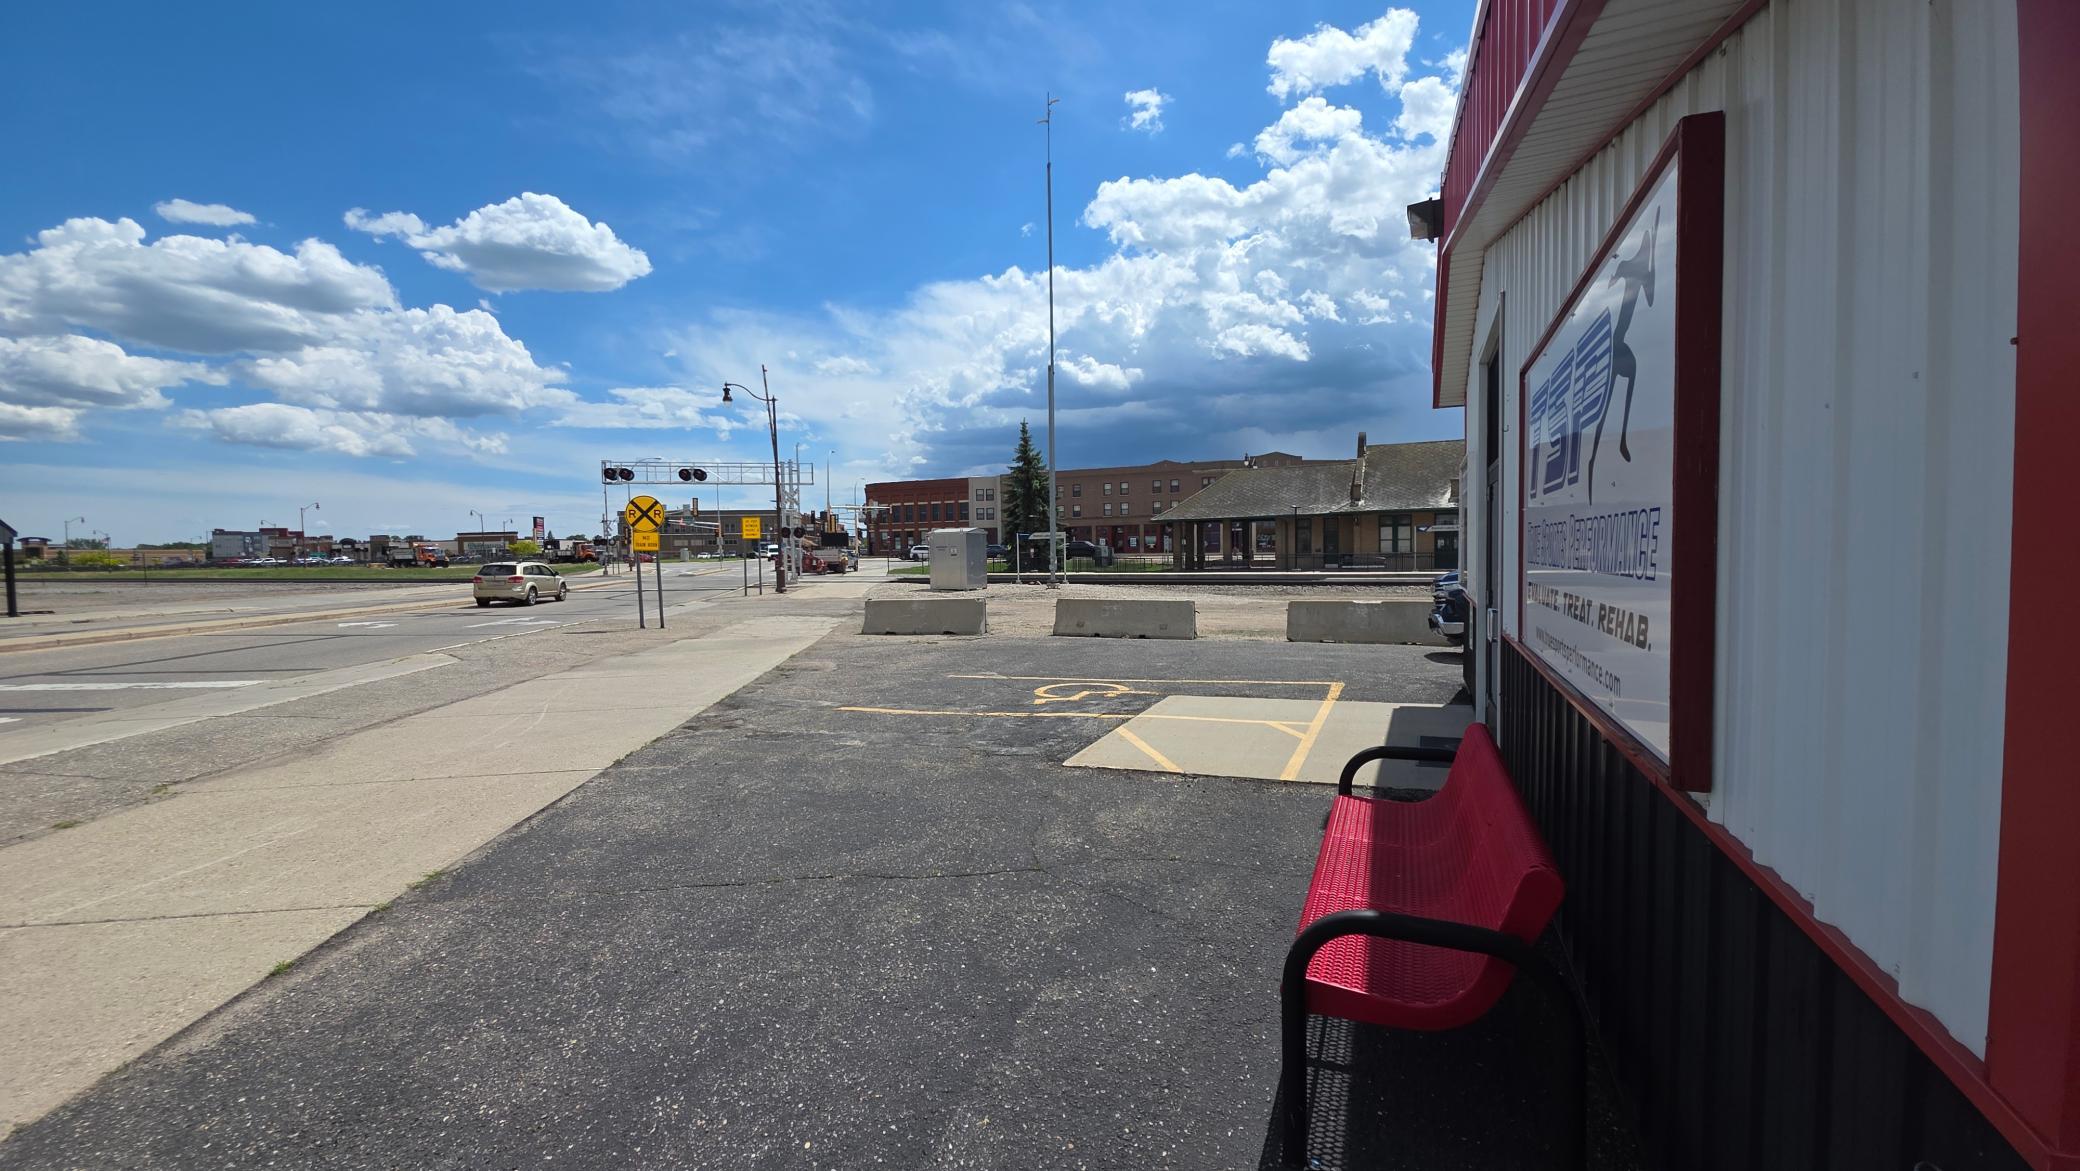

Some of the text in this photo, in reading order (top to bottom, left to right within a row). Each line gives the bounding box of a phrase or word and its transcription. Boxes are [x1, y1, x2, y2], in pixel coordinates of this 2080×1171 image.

[1529, 306, 1613, 499] TSP
[628, 509, 661, 519] R R
[1568, 507, 1661, 581] PERFORMANCE
[1563, 592, 1594, 627] TREAT.
[1598, 602, 1652, 652] REHAB.
